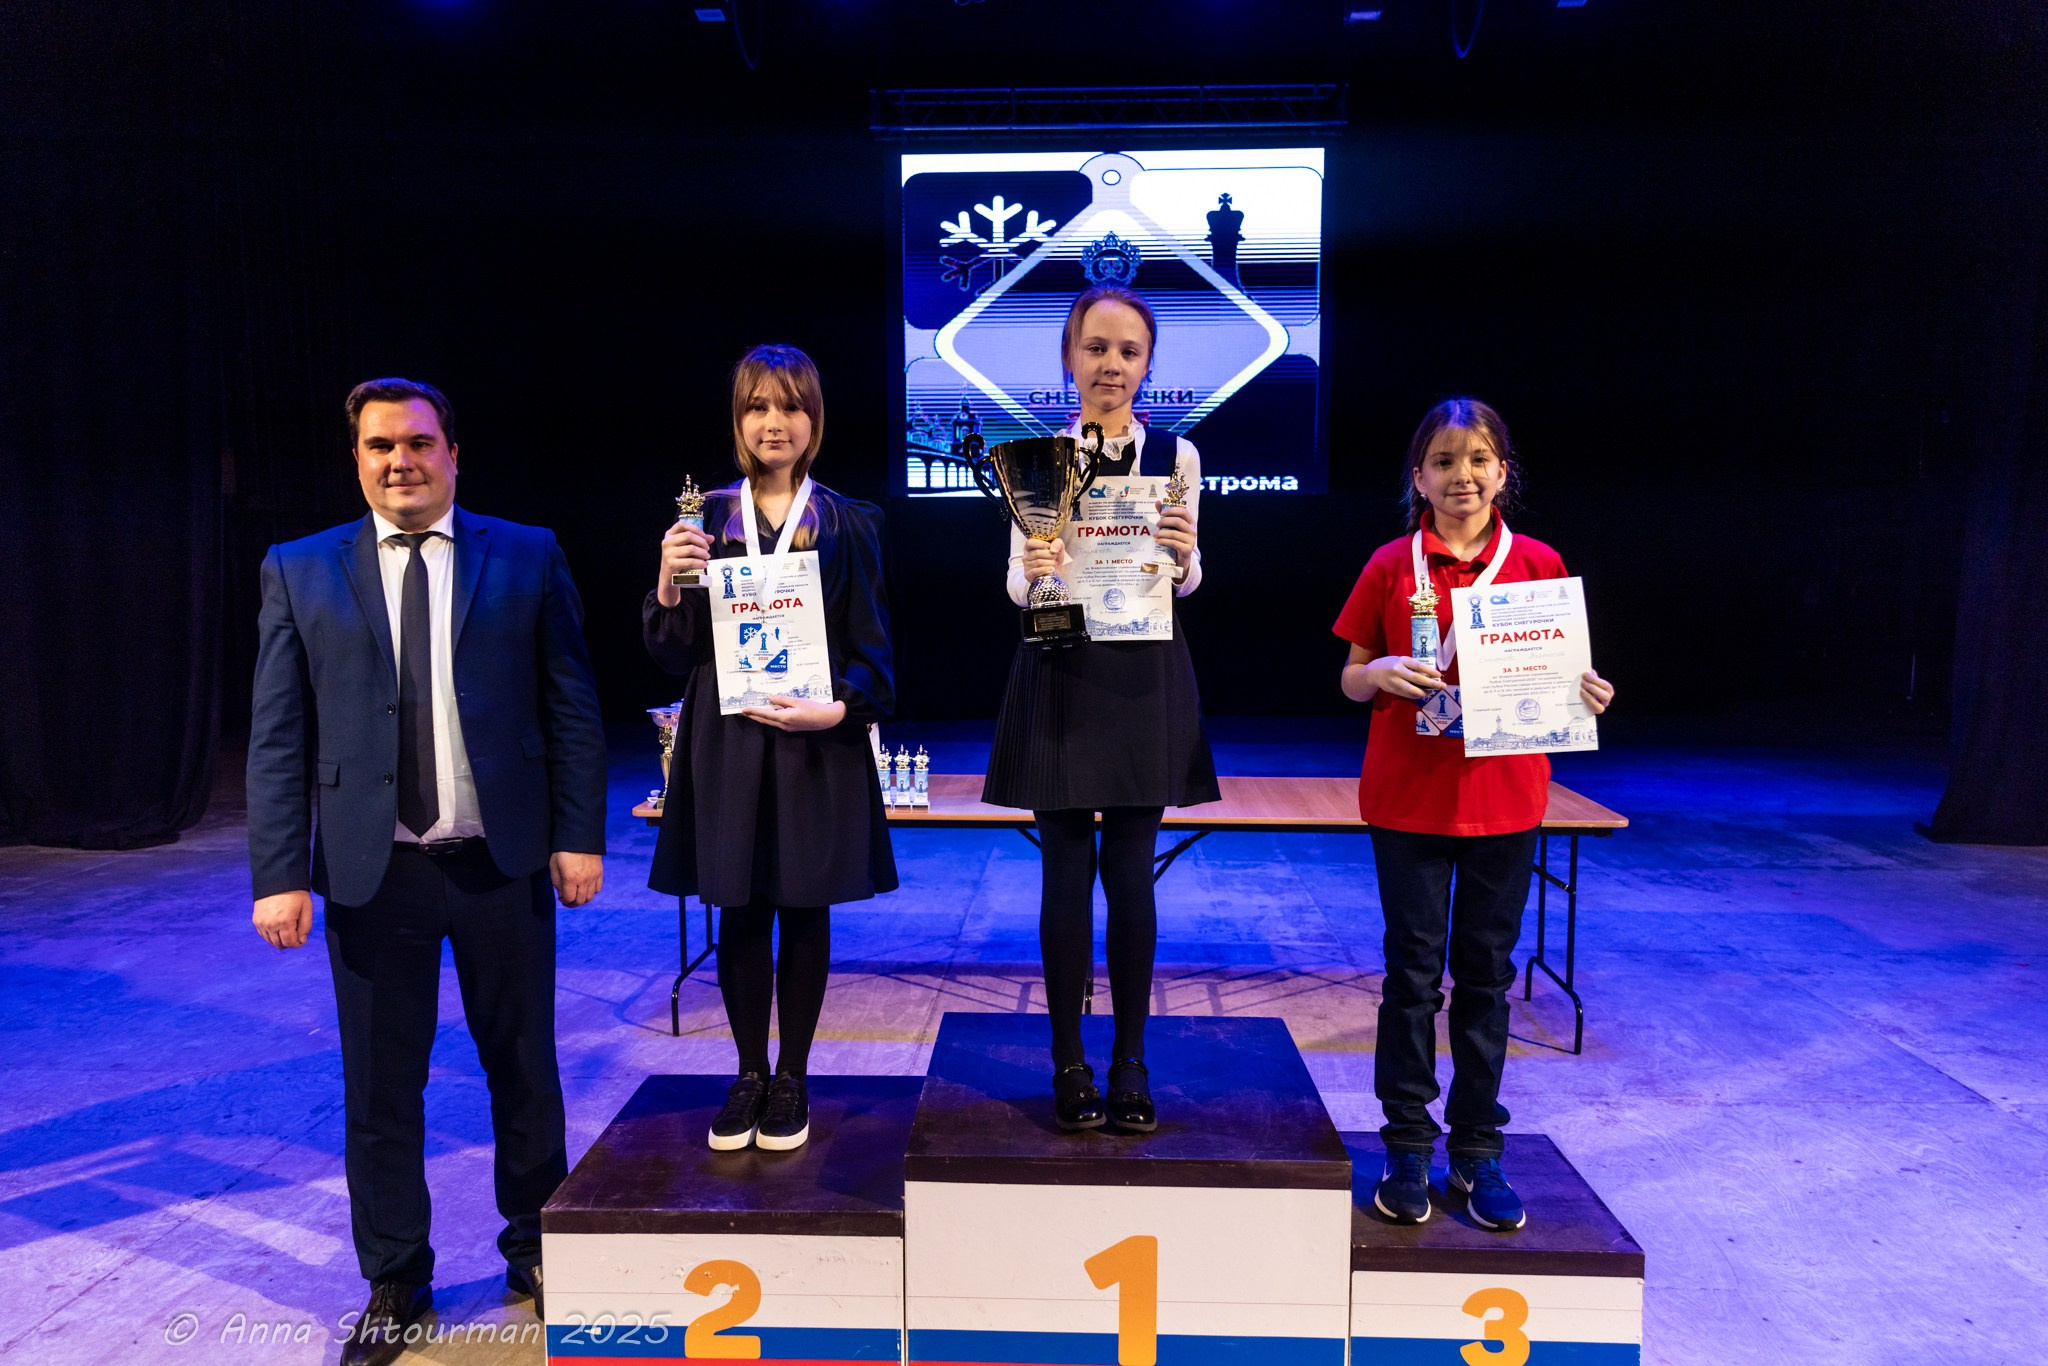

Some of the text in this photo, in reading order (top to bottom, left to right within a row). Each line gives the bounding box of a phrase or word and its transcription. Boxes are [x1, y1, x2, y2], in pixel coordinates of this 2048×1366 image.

[1029, 390, 1193, 405] СНЕЧКИ
[1200, 476, 1299, 495] трома
[1077, 525, 1151, 538] ГРАМОТА
[1480, 628, 1565, 645] ГРАМОТА
[779, 655, 786, 664] 2
[683, 1259, 761, 1360] 2
[1083, 1235, 1158, 1366] 1
[1460, 1287, 1530, 1366] 3
